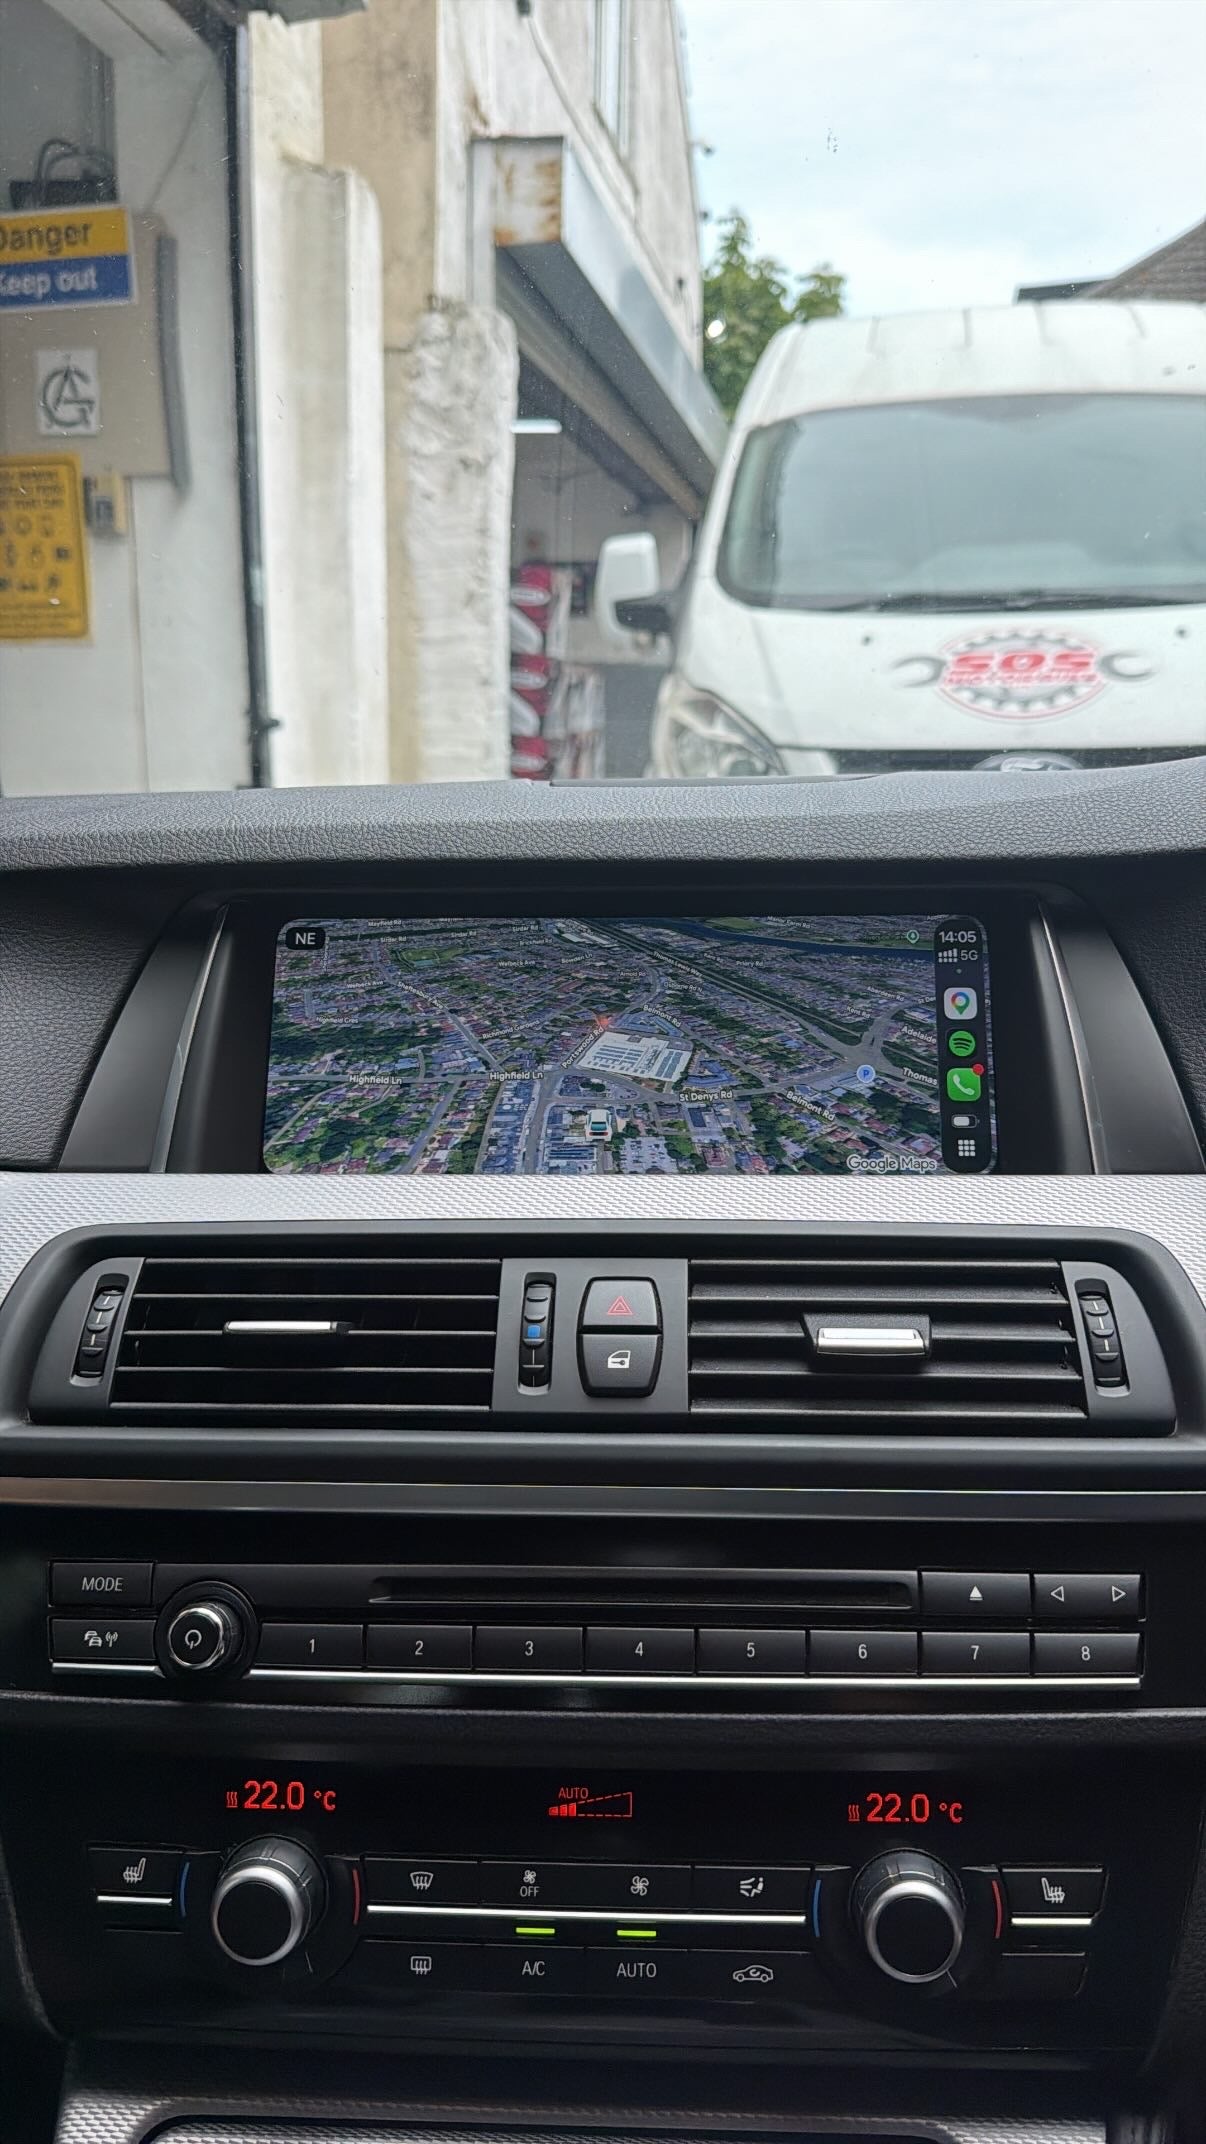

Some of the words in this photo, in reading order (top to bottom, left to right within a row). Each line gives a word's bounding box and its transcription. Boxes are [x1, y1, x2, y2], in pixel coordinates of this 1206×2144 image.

[55, 265, 97, 292] out
[954, 652, 1095, 673] SOS
[295, 932, 316, 945] NE
[939, 931, 977, 943] 14:05
[960, 950, 978, 961] 5G
[643, 1005, 672, 1021] Belmont
[672, 1018, 681, 1028] Rd
[861, 1011, 871, 1019] Rd
[482, 1027, 513, 1039] Richmond
[901, 1026, 937, 1043] Adelaide
[562, 1033, 595, 1069] Portswood
[593, 1026, 604, 1037] Rd
[349, 1075, 389, 1085] Highfield
[391, 1077, 402, 1085] Ln
[490, 1071, 530, 1081] Highfield
[902, 1067, 938, 1086] Thomas
[679, 1093, 689, 1101] St
[691, 1092, 718, 1102] Denys
[720, 1090, 733, 1099] Rd
[786, 1090, 822, 1114] Belmont
[823, 1110, 835, 1121] Rd
[847, 1154, 898, 1173] Google
[901, 1156, 937, 1173] Maps
[81, 1577, 123, 1592] MODE
[309, 1639, 316, 1653] 1
[415, 1641, 424, 1655] 2
[525, 1641, 534, 1656] 3
[635, 1642, 644, 1657] 4
[747, 1642, 755, 1658] 5
[858, 1644, 867, 1659] 6
[971, 1645, 979, 1660] 7
[1081, 1646, 1091, 1661] 8
[244, 1780, 305, 1811] 22.0
[558, 1787, 589, 1800] AUTO
[866, 1793, 930, 1823] 22.0
[519, 1885, 539, 1898] OFF
[522, 1960, 545, 1977] A/C
[616, 1963, 657, 1979] AUTO
